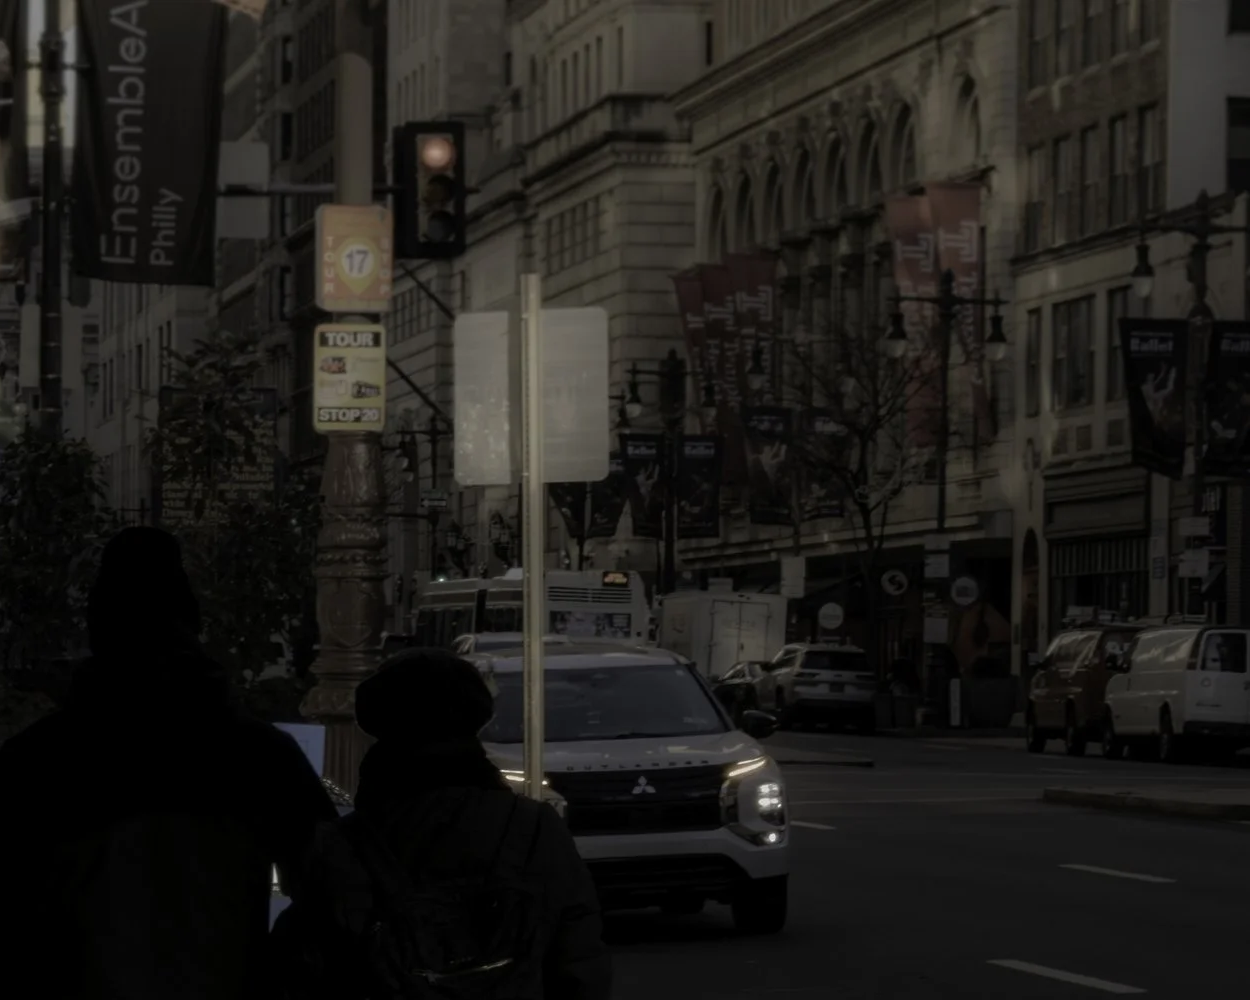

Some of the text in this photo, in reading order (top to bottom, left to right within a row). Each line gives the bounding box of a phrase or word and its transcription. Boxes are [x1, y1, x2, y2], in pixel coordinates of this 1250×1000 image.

[151, 187, 184, 267] Philly
[323, 236, 335, 295] TOUR
[346, 249, 369, 274] 17
[325, 331, 375, 347] TOUR
[318, 407, 379, 423] STOP 20
